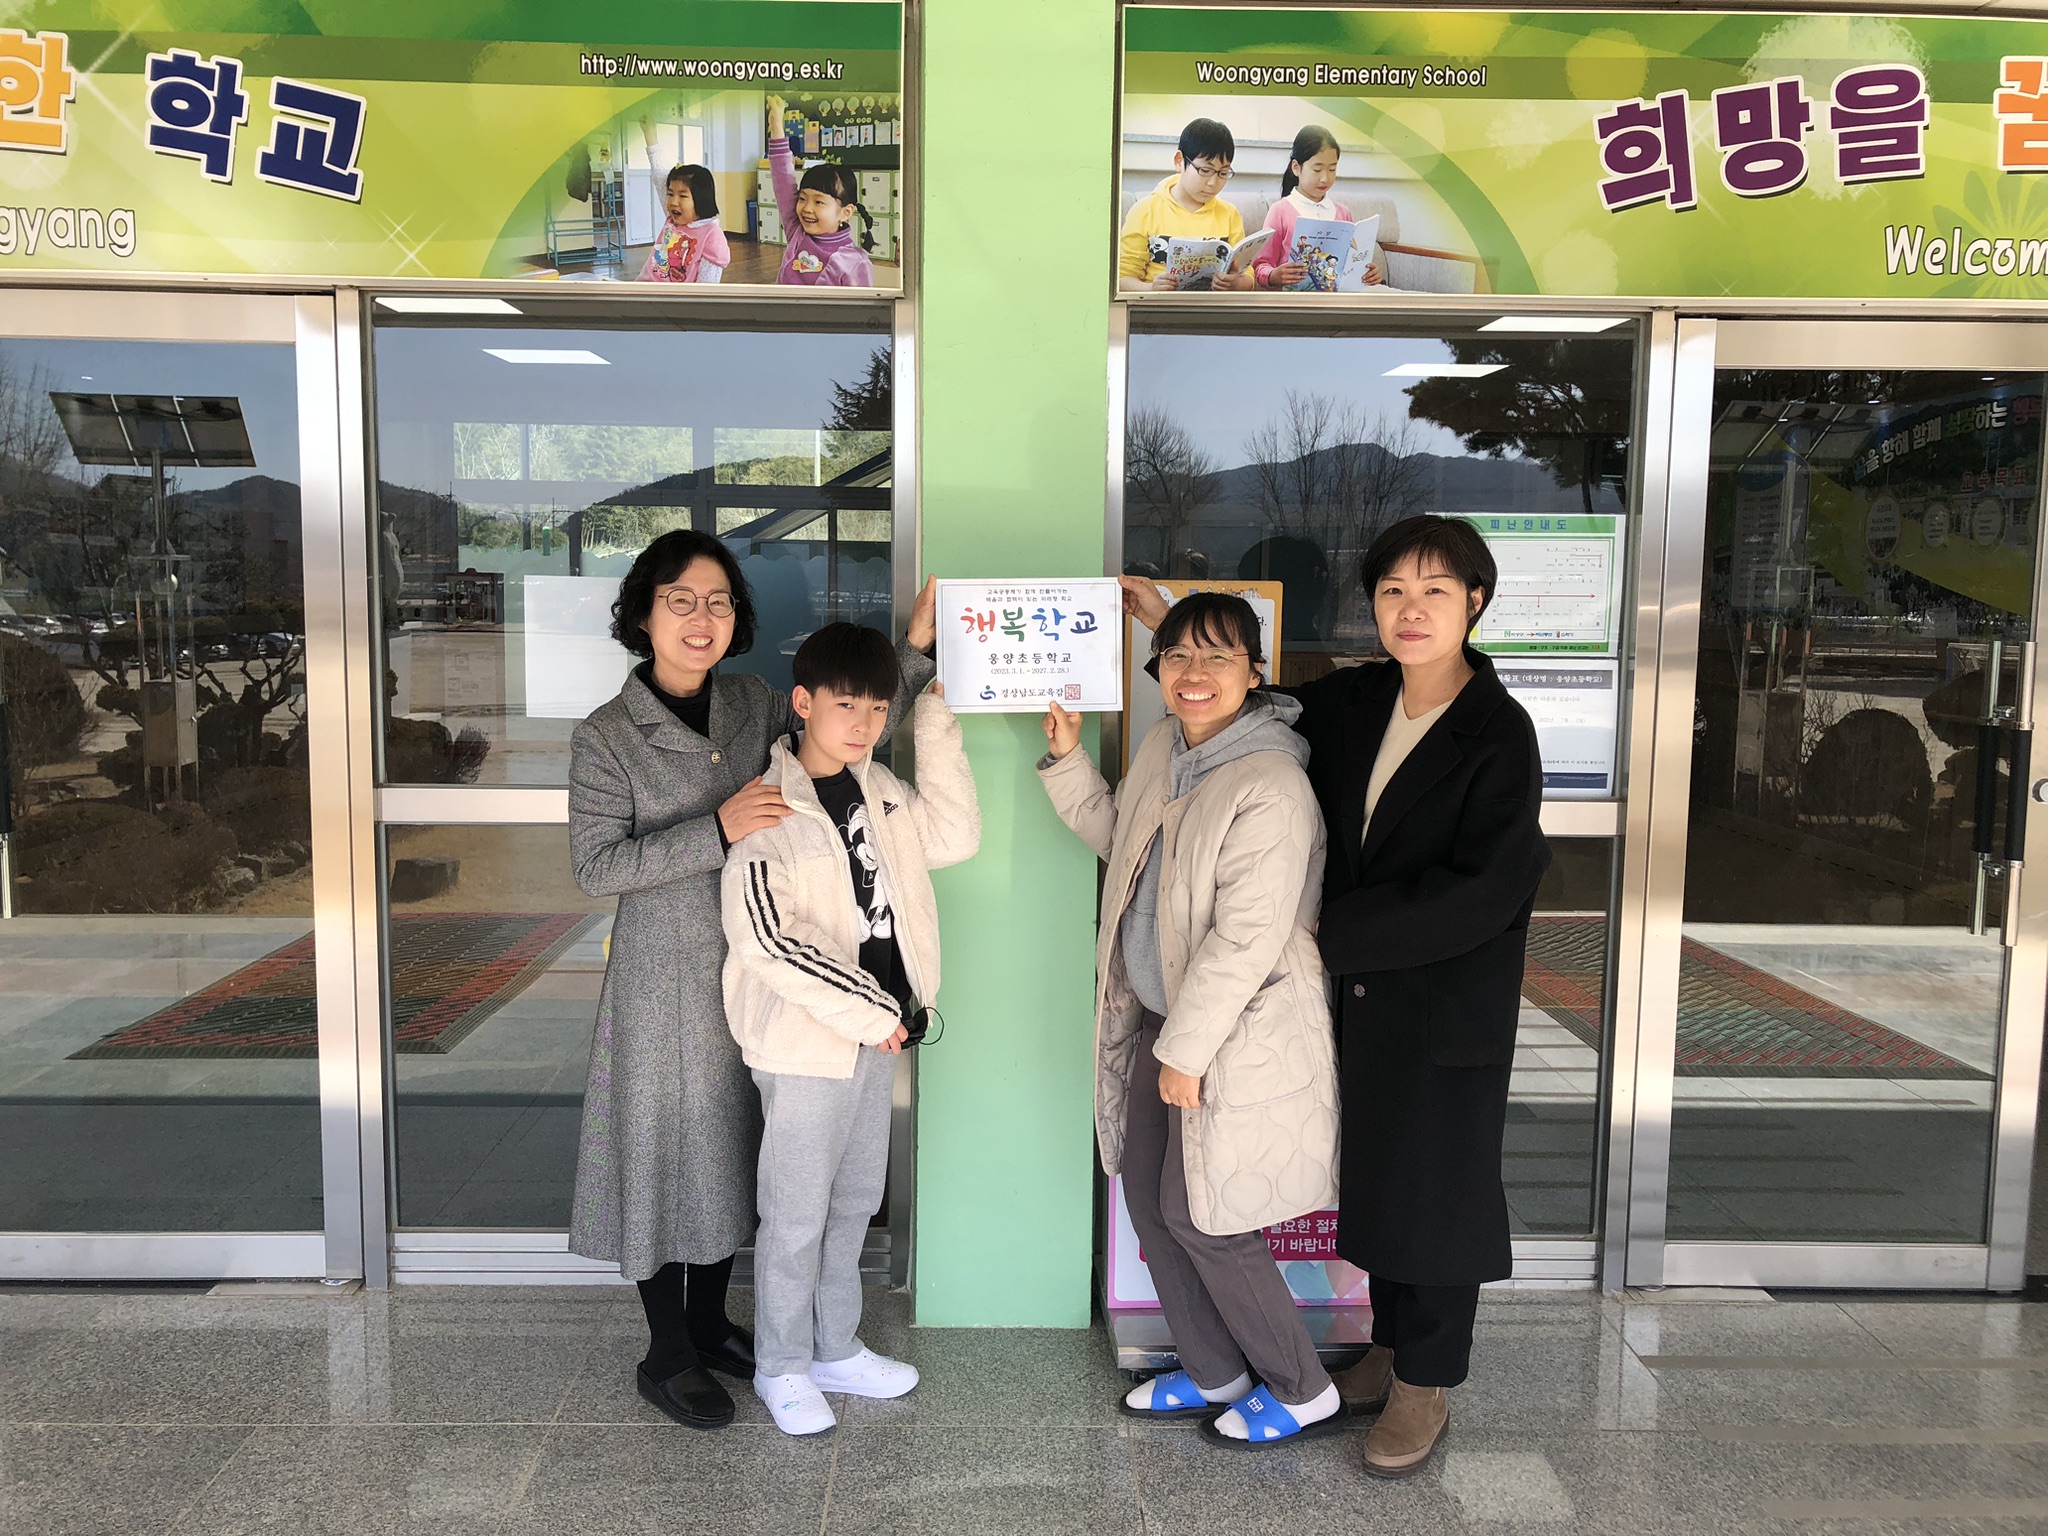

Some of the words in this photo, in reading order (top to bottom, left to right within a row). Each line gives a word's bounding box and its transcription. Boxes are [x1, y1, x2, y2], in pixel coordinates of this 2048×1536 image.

[580, 54, 844, 81] http://www.woongyang.es.kr
[1196, 62, 1309, 85] Woongyang
[1314, 64, 1418, 88] Elementary
[1422, 65, 1487, 86] School
[146, 48, 365, 201] 학교
[1594, 62, 1929, 211] 희망을
[1490, 519, 1567, 531] 피난안내도
[960, 606, 1098, 643] 행복학교
[988, 652, 1072, 665] 웅양초등학교
[1000, 688, 1064, 698] 경상남도교육감
